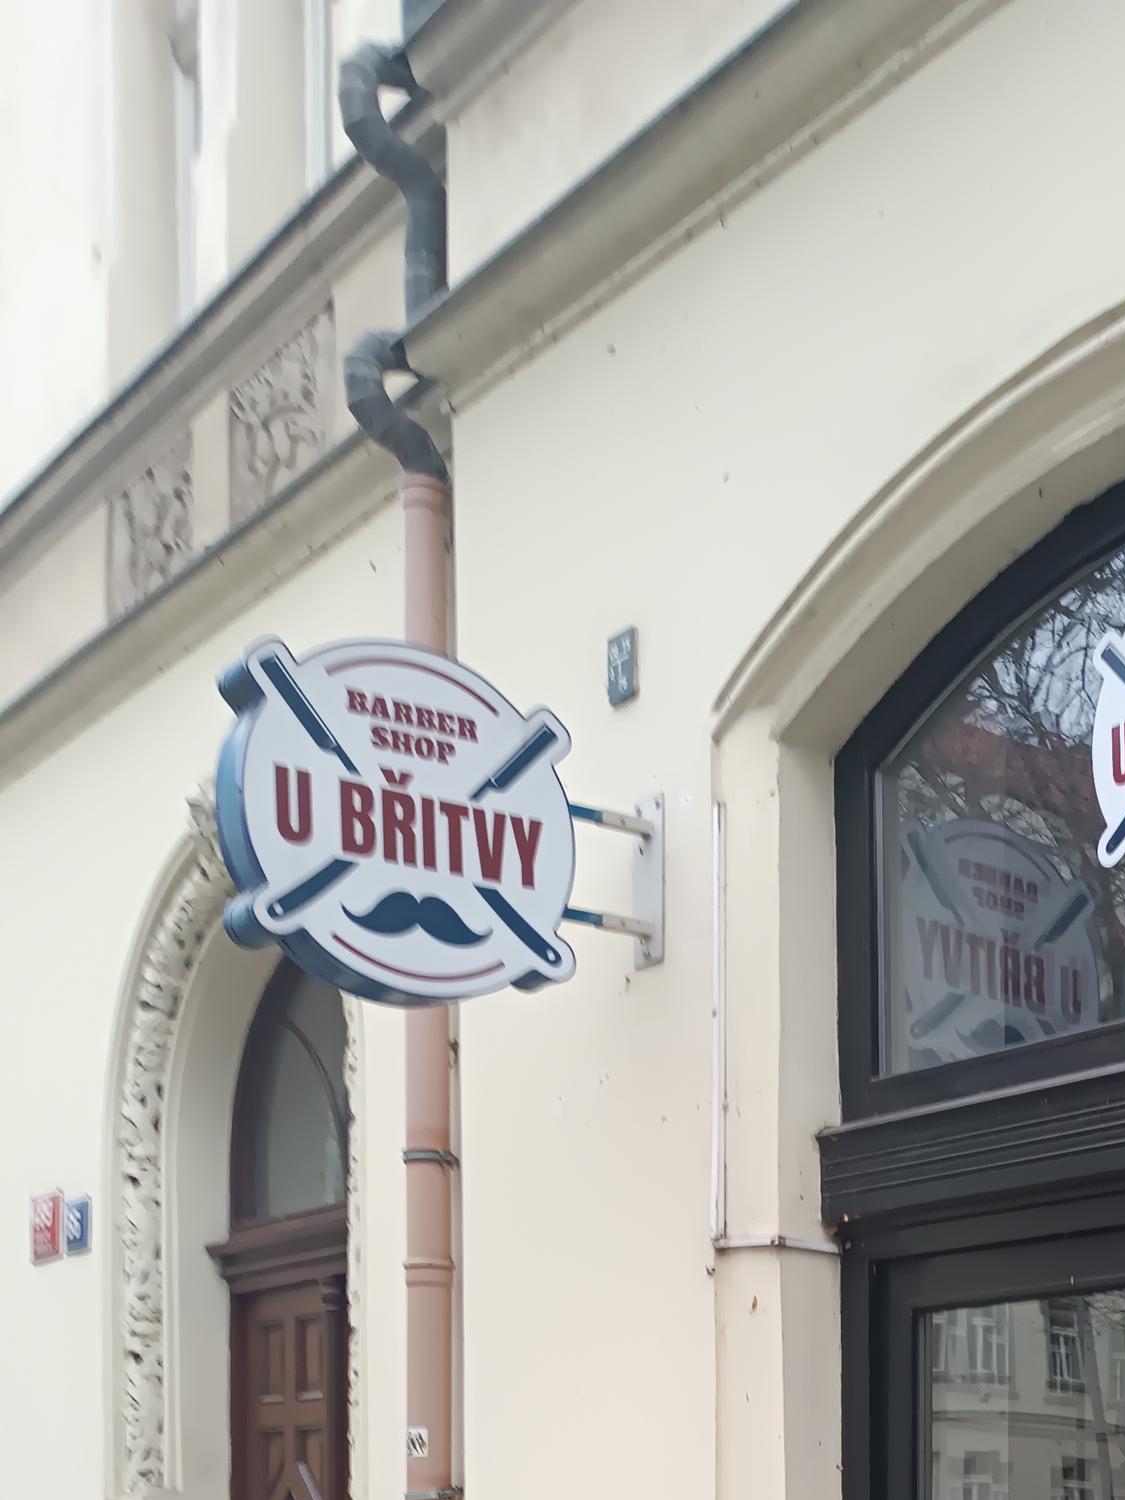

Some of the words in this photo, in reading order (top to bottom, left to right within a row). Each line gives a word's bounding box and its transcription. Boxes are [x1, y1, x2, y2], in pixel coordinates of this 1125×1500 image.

[346, 688, 479, 743] BARBER
[371, 726, 456, 765] SHOP
[274, 763, 312, 844] U
[339, 765, 543, 889] BŘITVY
